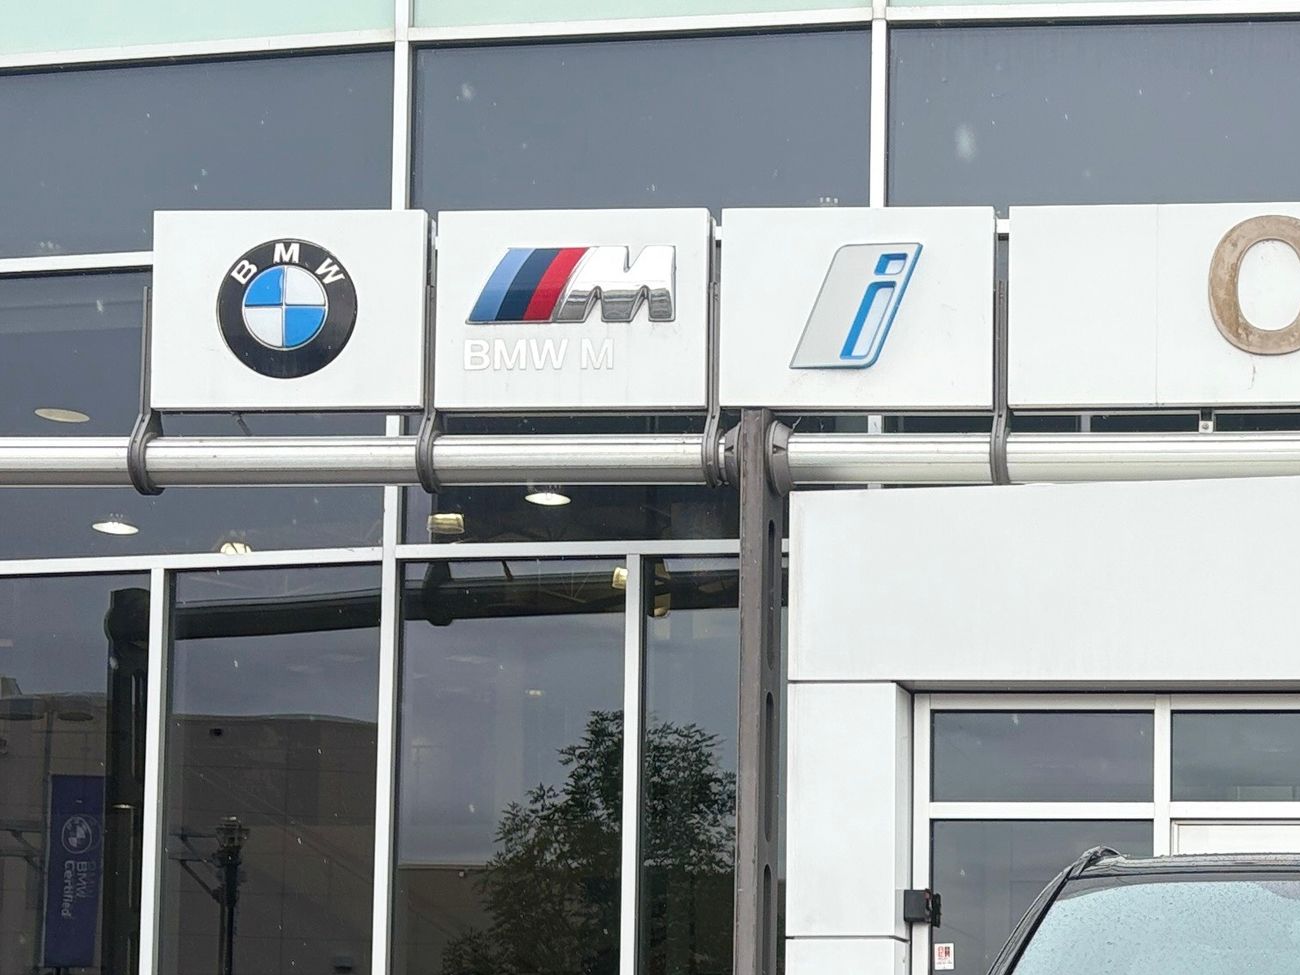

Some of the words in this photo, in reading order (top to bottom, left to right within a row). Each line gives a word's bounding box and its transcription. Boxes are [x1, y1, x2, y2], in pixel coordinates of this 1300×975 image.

[230, 242, 346, 285] BMW
[463, 338, 569, 371] BMW
[580, 337, 615, 371] M
[61, 860, 75, 918] Certified
[76, 861, 88, 898] BMW
